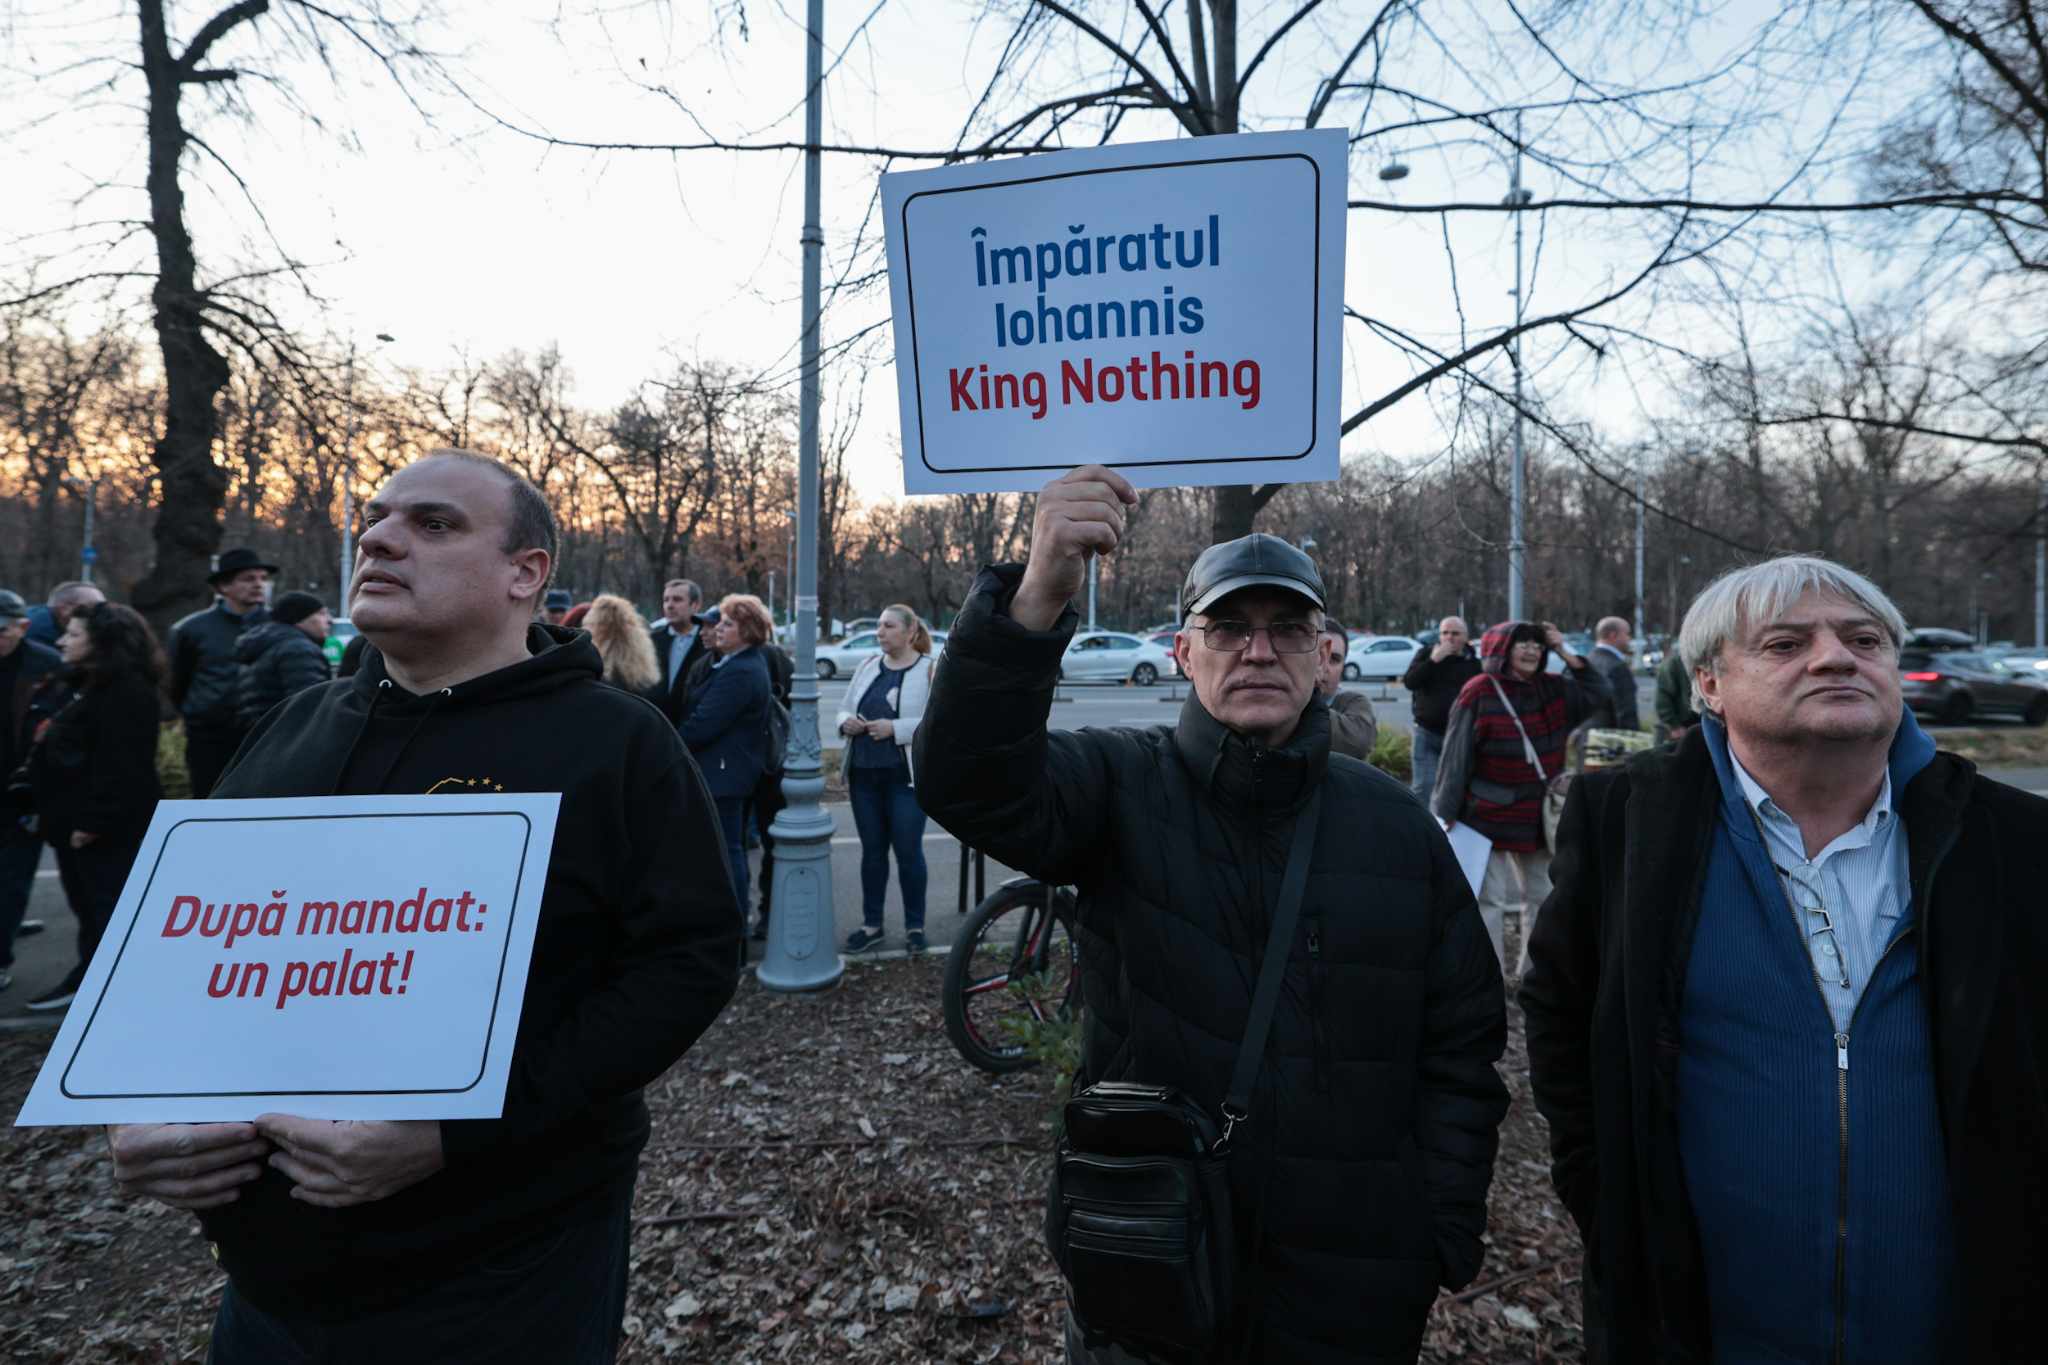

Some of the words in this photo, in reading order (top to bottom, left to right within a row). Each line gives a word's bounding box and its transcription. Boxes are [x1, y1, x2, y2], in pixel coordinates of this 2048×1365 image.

[971, 214, 1219, 293] Împăratul
[995, 286, 1204, 347] Iohannis
[949, 364, 1047, 420] King
[1061, 351, 1260, 410] Nothing
[161, 889, 288, 949] După
[296, 887, 487, 935] mandat:
[207, 962, 269, 998] un
[275, 948, 414, 1009] palat!
